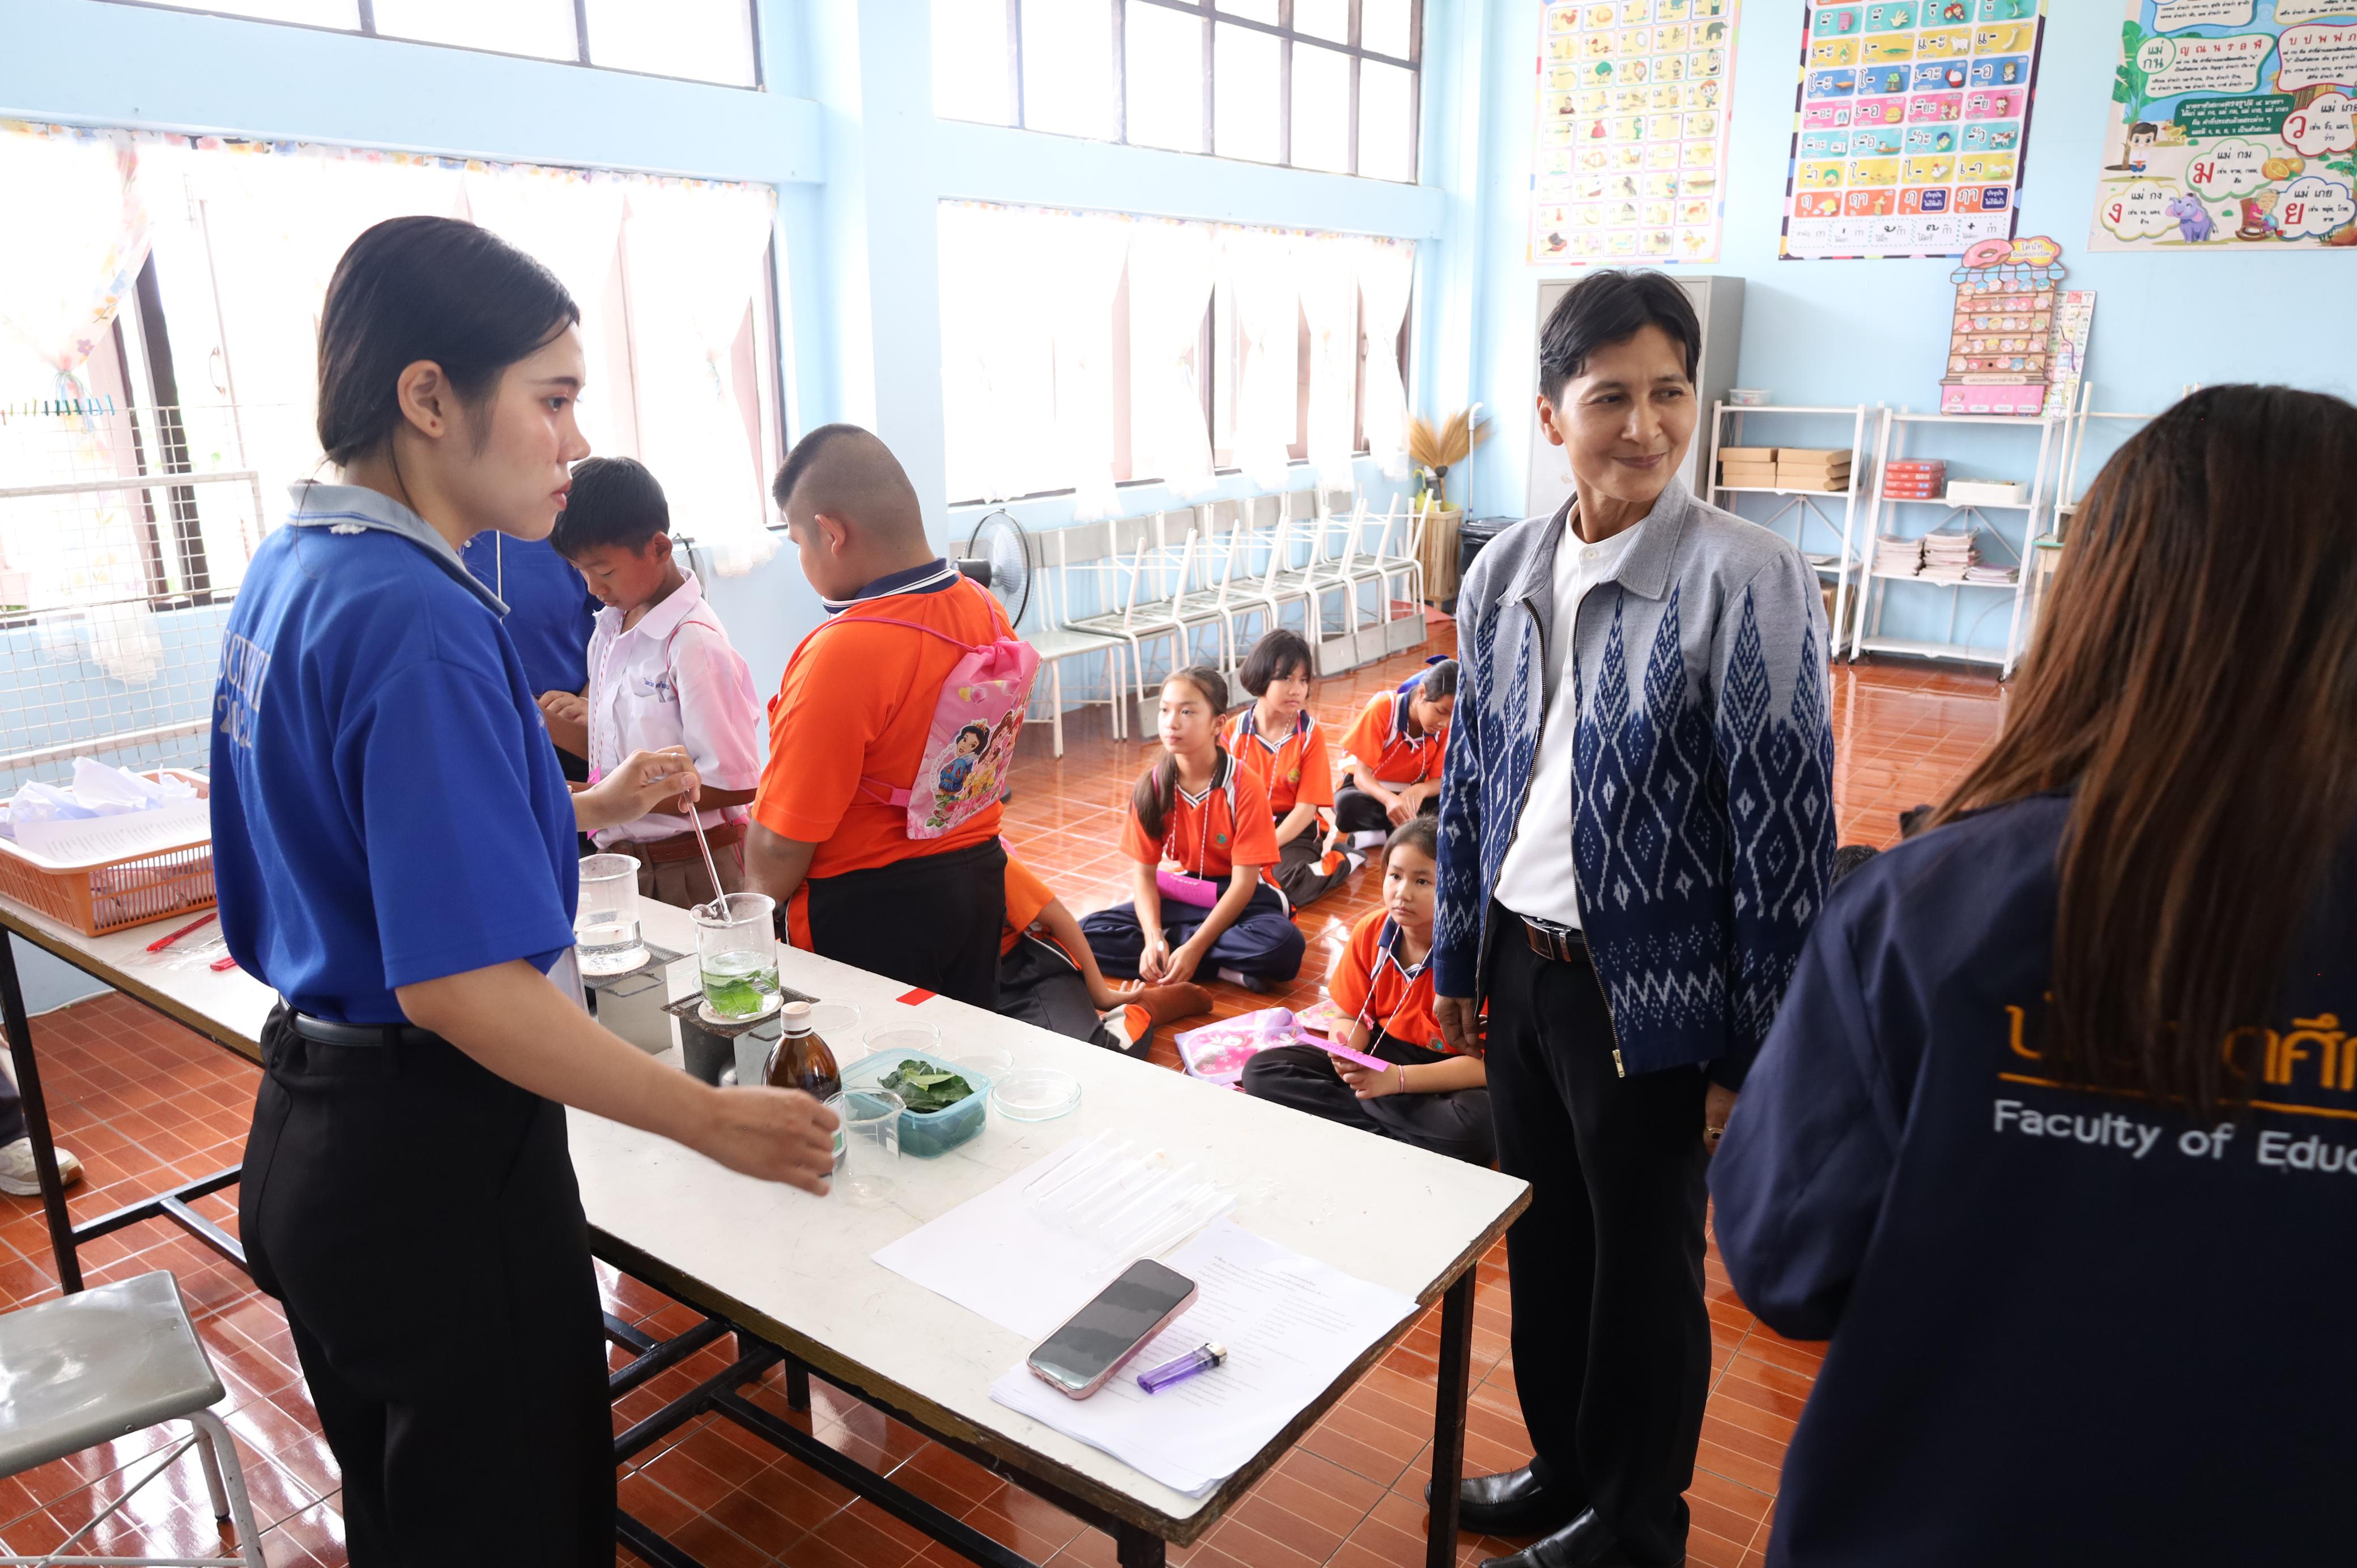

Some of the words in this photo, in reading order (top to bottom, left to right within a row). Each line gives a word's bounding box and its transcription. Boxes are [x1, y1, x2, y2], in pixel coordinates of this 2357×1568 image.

[2148, 40, 2164, 55] แม่
[2143, 58, 2164, 69] กน
[2321, 100, 2337, 113] แม่
[2289, 116, 2307, 139] ว
[2217, 147, 2232, 159] แม่
[2193, 162, 2215, 184] ม
[2131, 188, 2145, 200] แม่
[2294, 186, 2310, 198] แม่
[2108, 203, 2122, 223] ง
[2284, 203, 2305, 224] ย
[1993, 1099, 2162, 1159] Faculty
[2179, 1122, 2235, 1159] of
